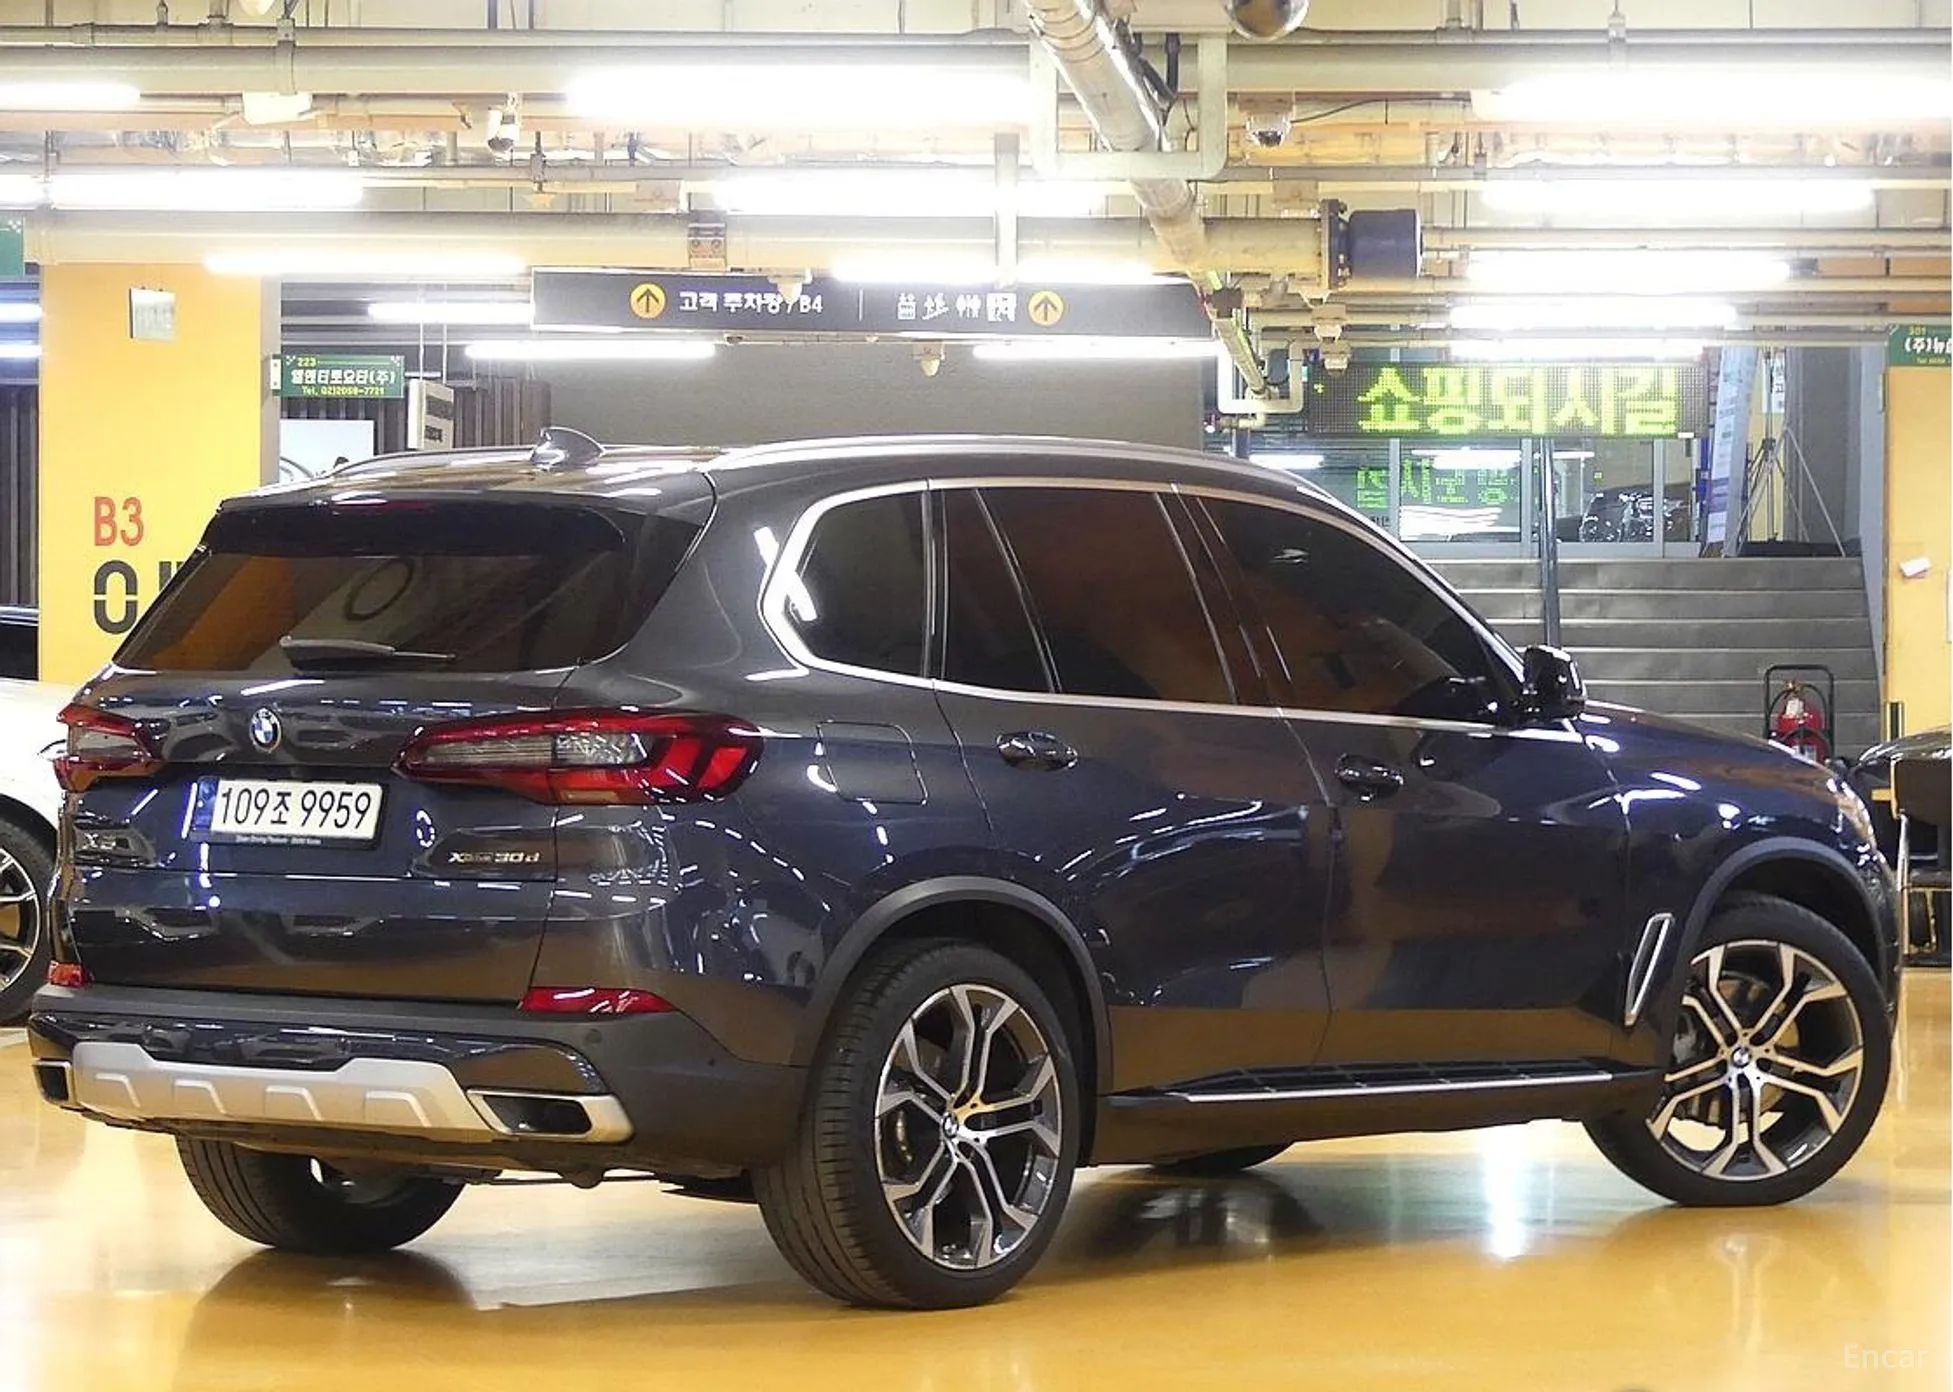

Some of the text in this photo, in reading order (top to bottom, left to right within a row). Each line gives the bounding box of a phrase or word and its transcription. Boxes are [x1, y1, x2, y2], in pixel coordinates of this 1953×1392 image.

[679, 291, 719, 312] 고객
[723, 292, 783, 314] 주차장
[799, 294, 823, 313] B4
[1357, 367, 1679, 435] 쇼핑되시길
[94, 496, 144, 546] B3
[221, 787, 372, 829] 109조 9959
